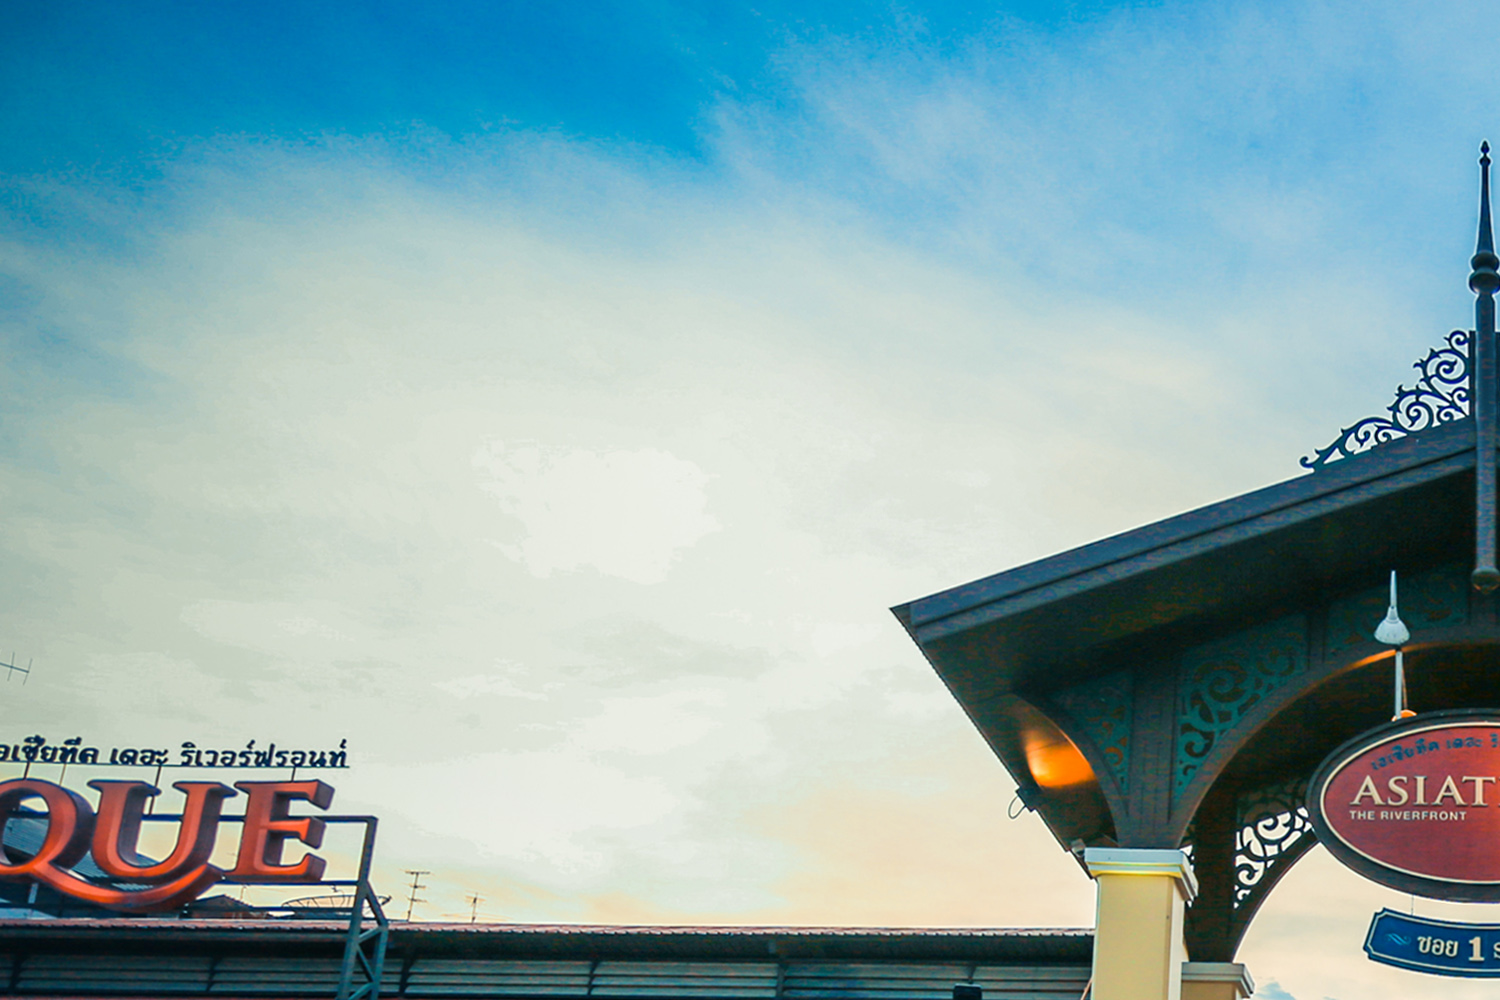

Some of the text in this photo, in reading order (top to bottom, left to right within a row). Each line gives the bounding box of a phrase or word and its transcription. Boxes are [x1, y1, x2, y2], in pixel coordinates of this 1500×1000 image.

[180, 740, 348, 768] ริเวอร์ฟรอนท์
[1350, 810, 1467, 821] THE RIVERFRONT
[1417, 936, 1459, 957] ซอย
[1468, 936, 1485, 962] 1
